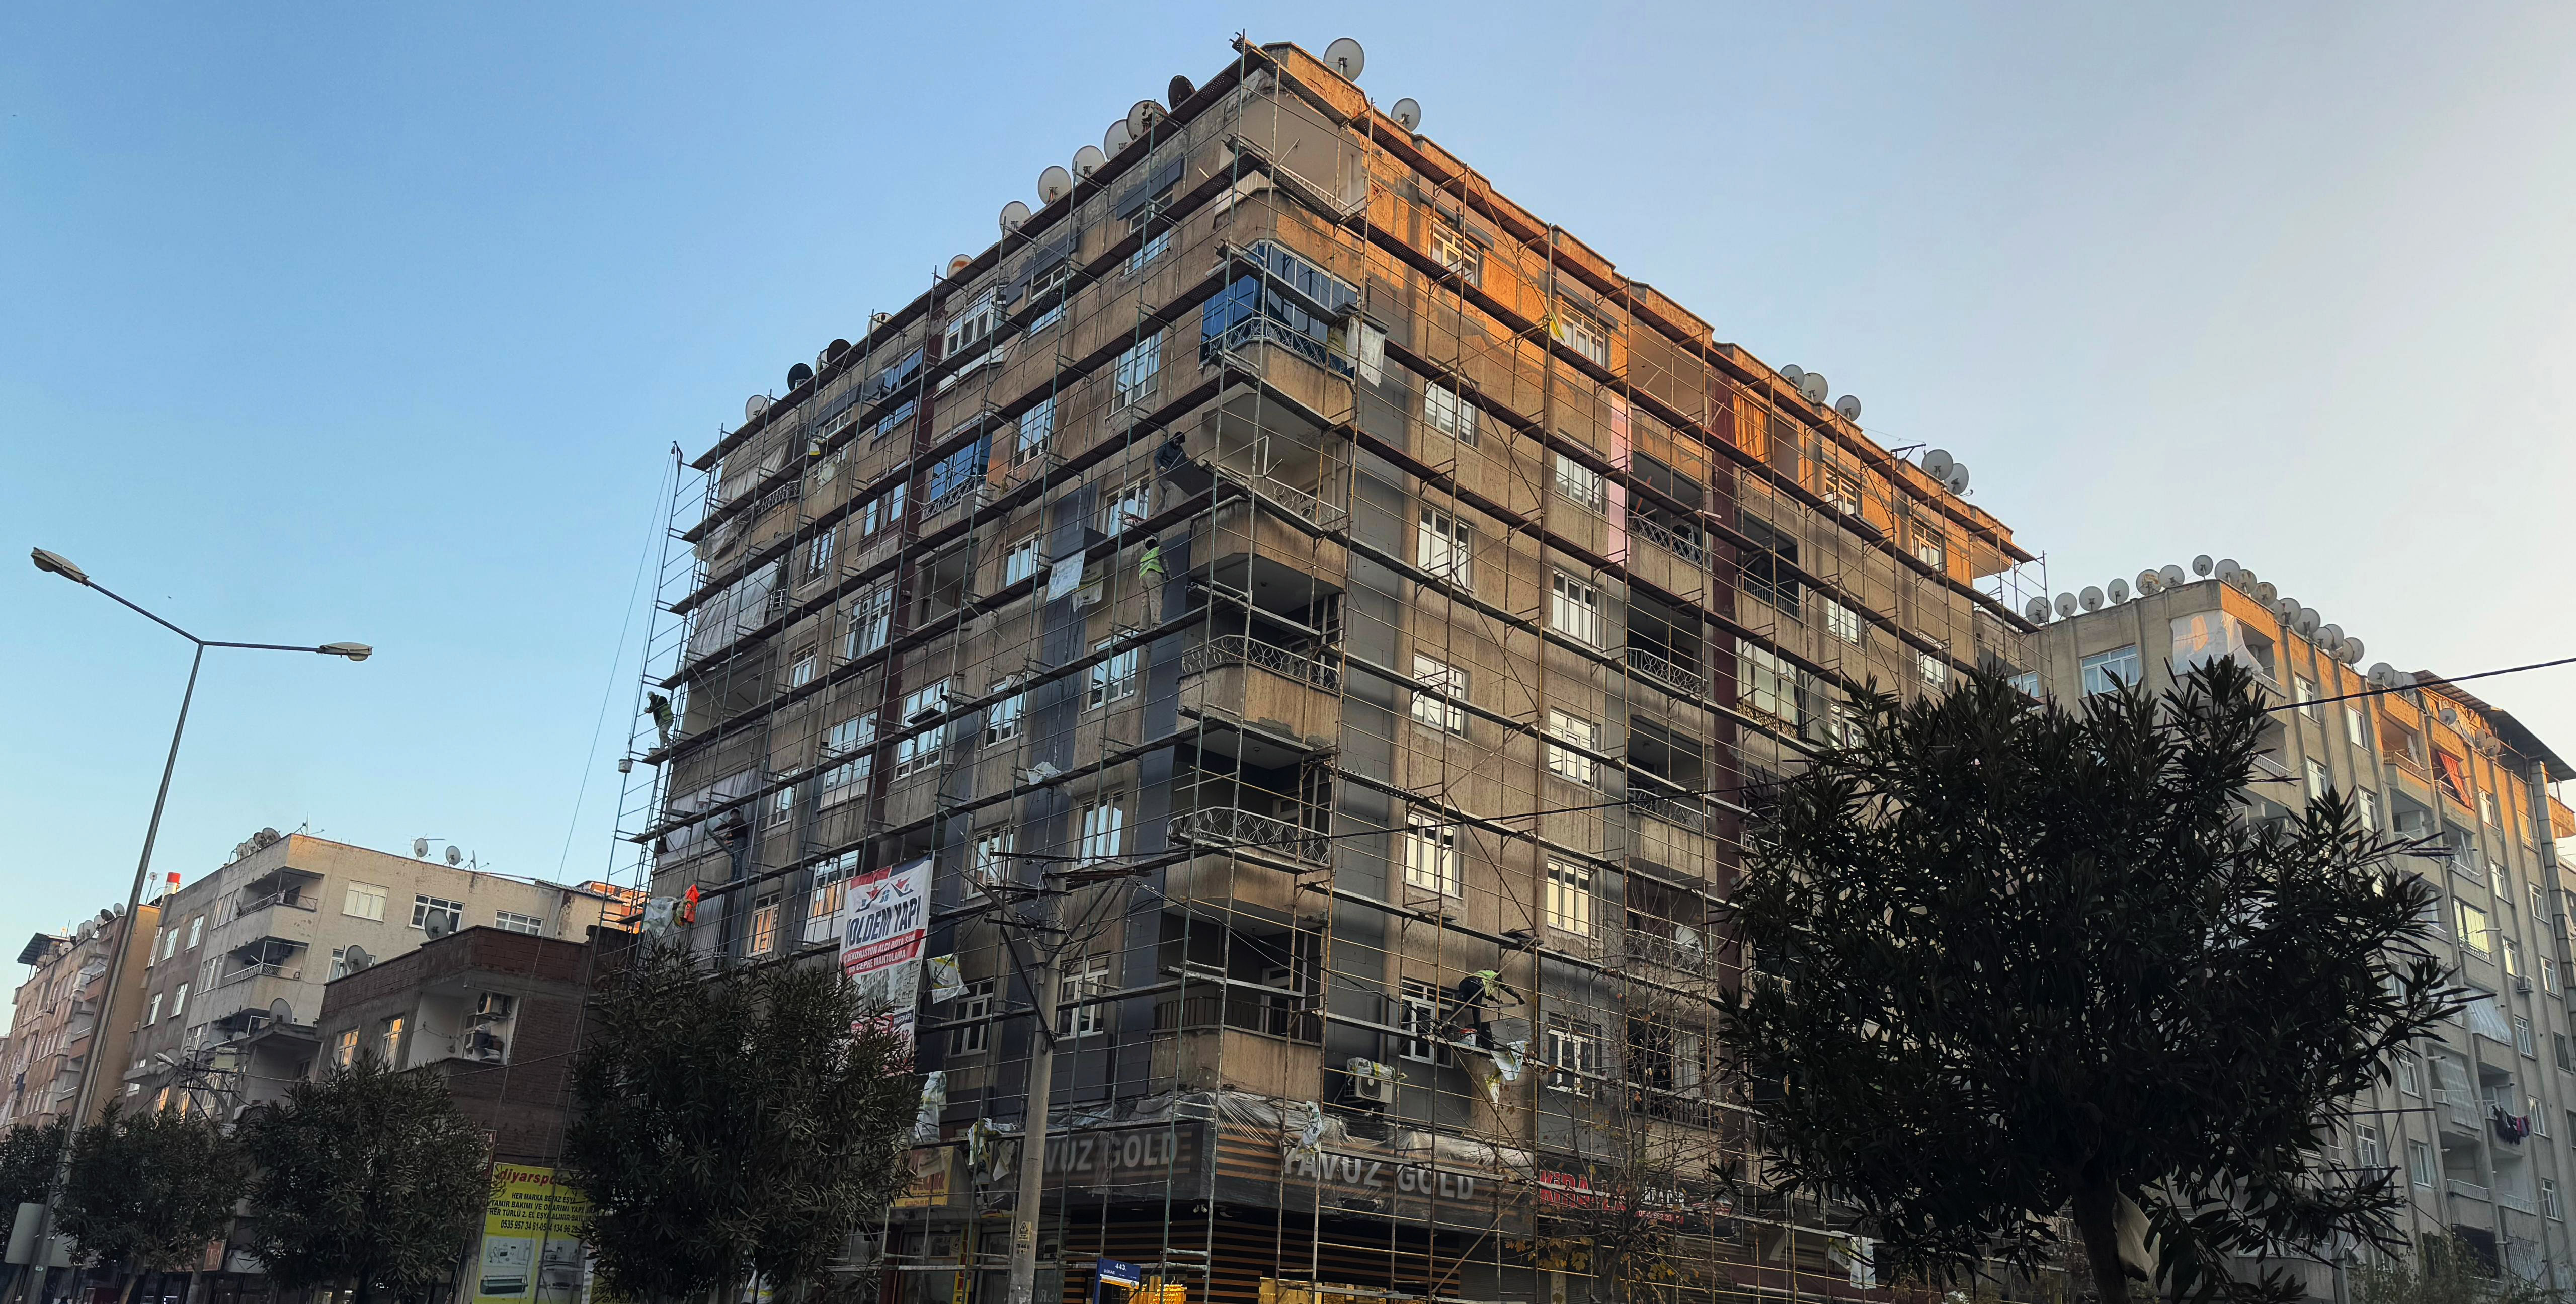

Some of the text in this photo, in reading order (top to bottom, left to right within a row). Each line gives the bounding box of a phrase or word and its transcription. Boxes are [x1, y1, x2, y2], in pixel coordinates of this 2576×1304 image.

[894, 895, 921, 933] YAPI
[1104, 1132, 1178, 1168] GOLD
[1283, 1145, 1474, 1200] YAVUZ GOLD
